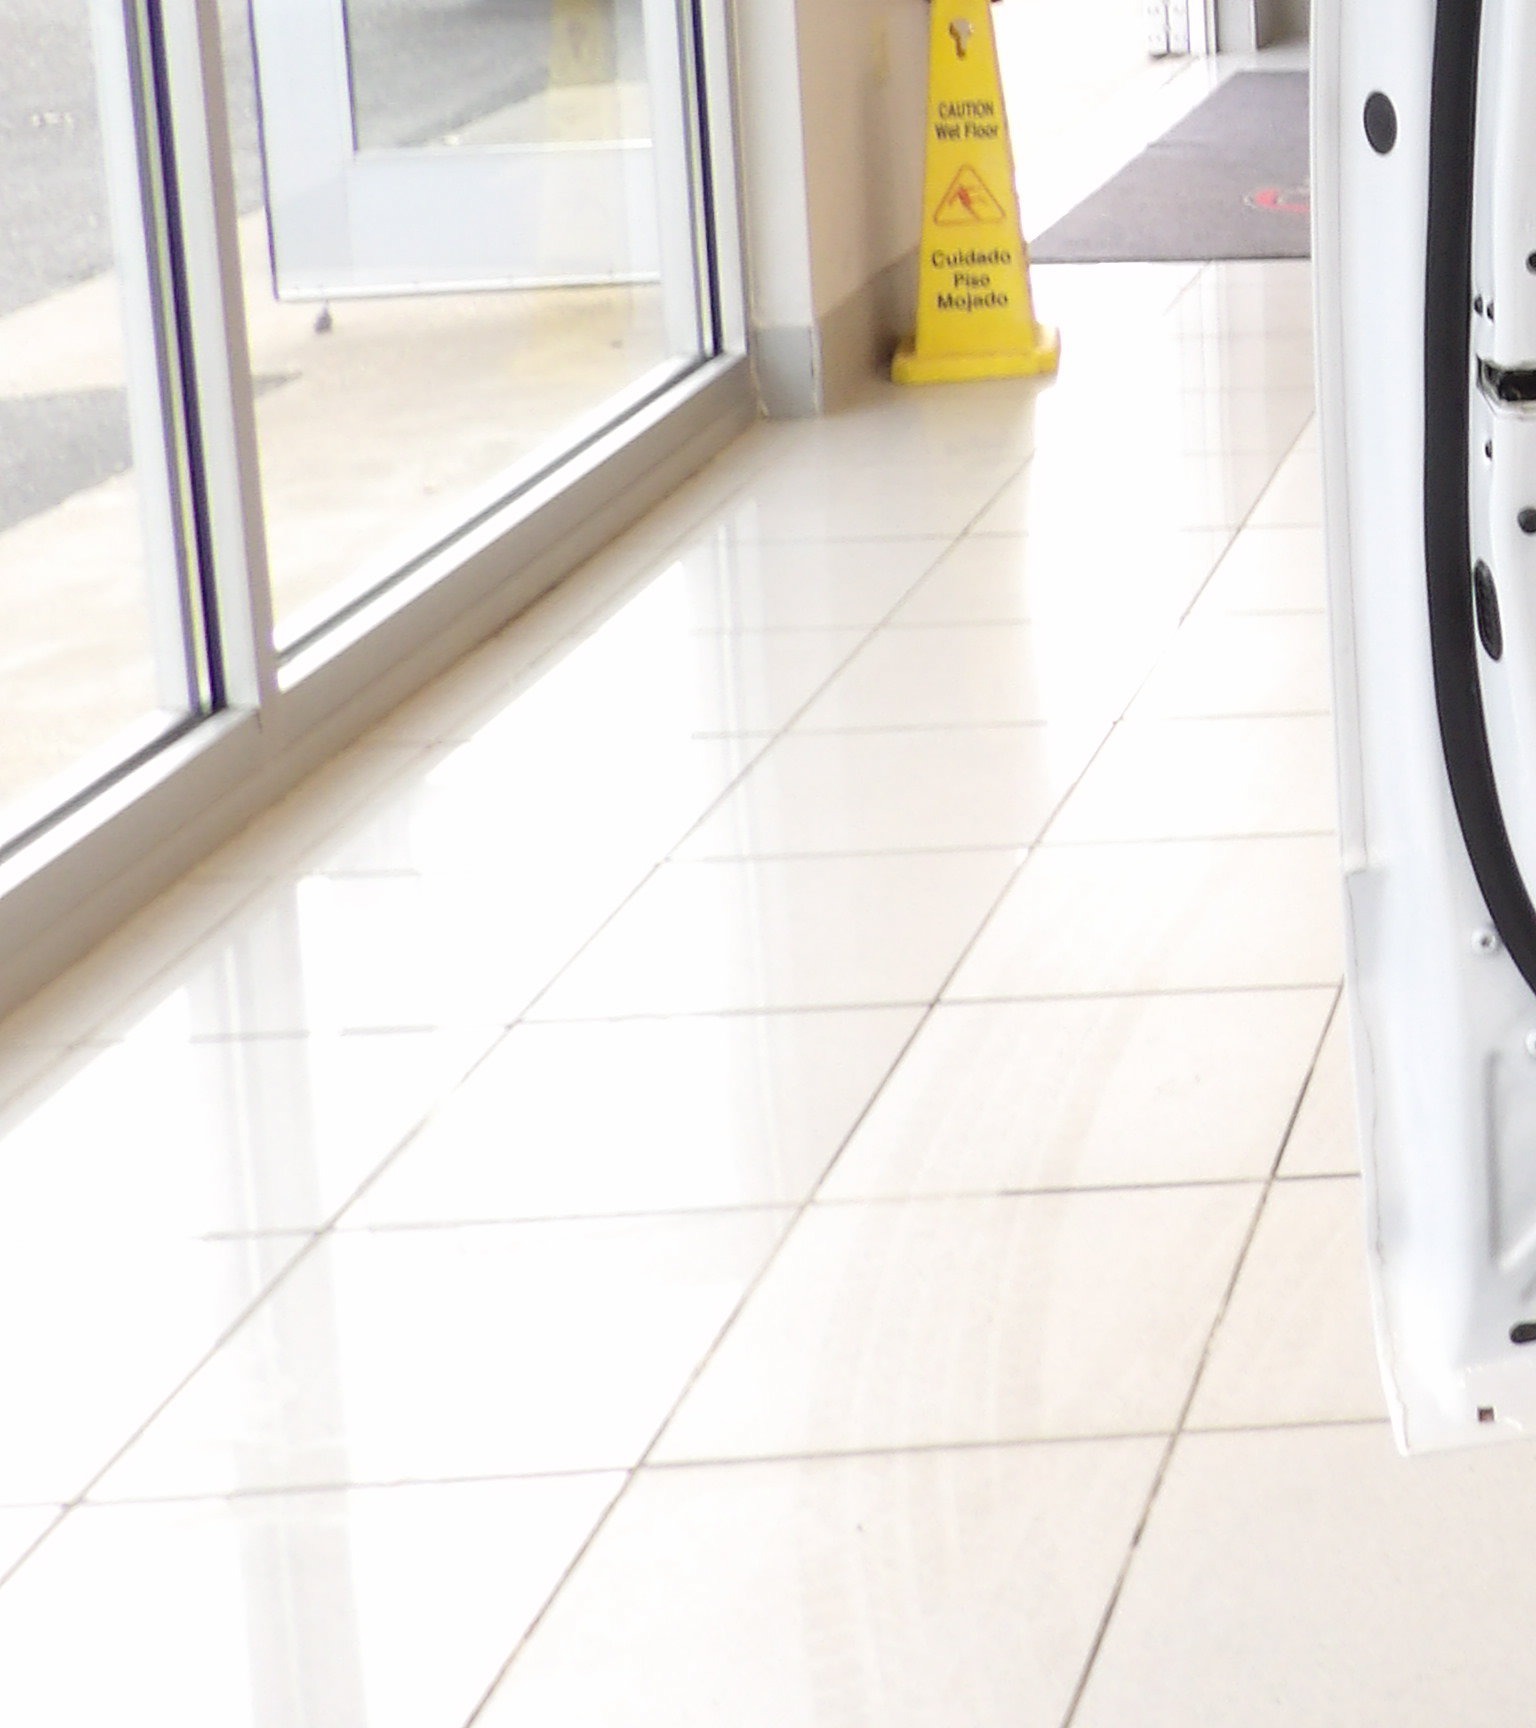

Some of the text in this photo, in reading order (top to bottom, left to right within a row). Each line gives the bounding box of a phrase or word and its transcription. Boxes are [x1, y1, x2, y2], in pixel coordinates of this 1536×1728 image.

[938, 101, 994, 119] CAUTION
[934, 122, 998, 140] Wet Floor
[931, 249, 1011, 268] Cuidado
[953, 272, 991, 288] Piso
[936, 292, 1008, 312] Mojado
